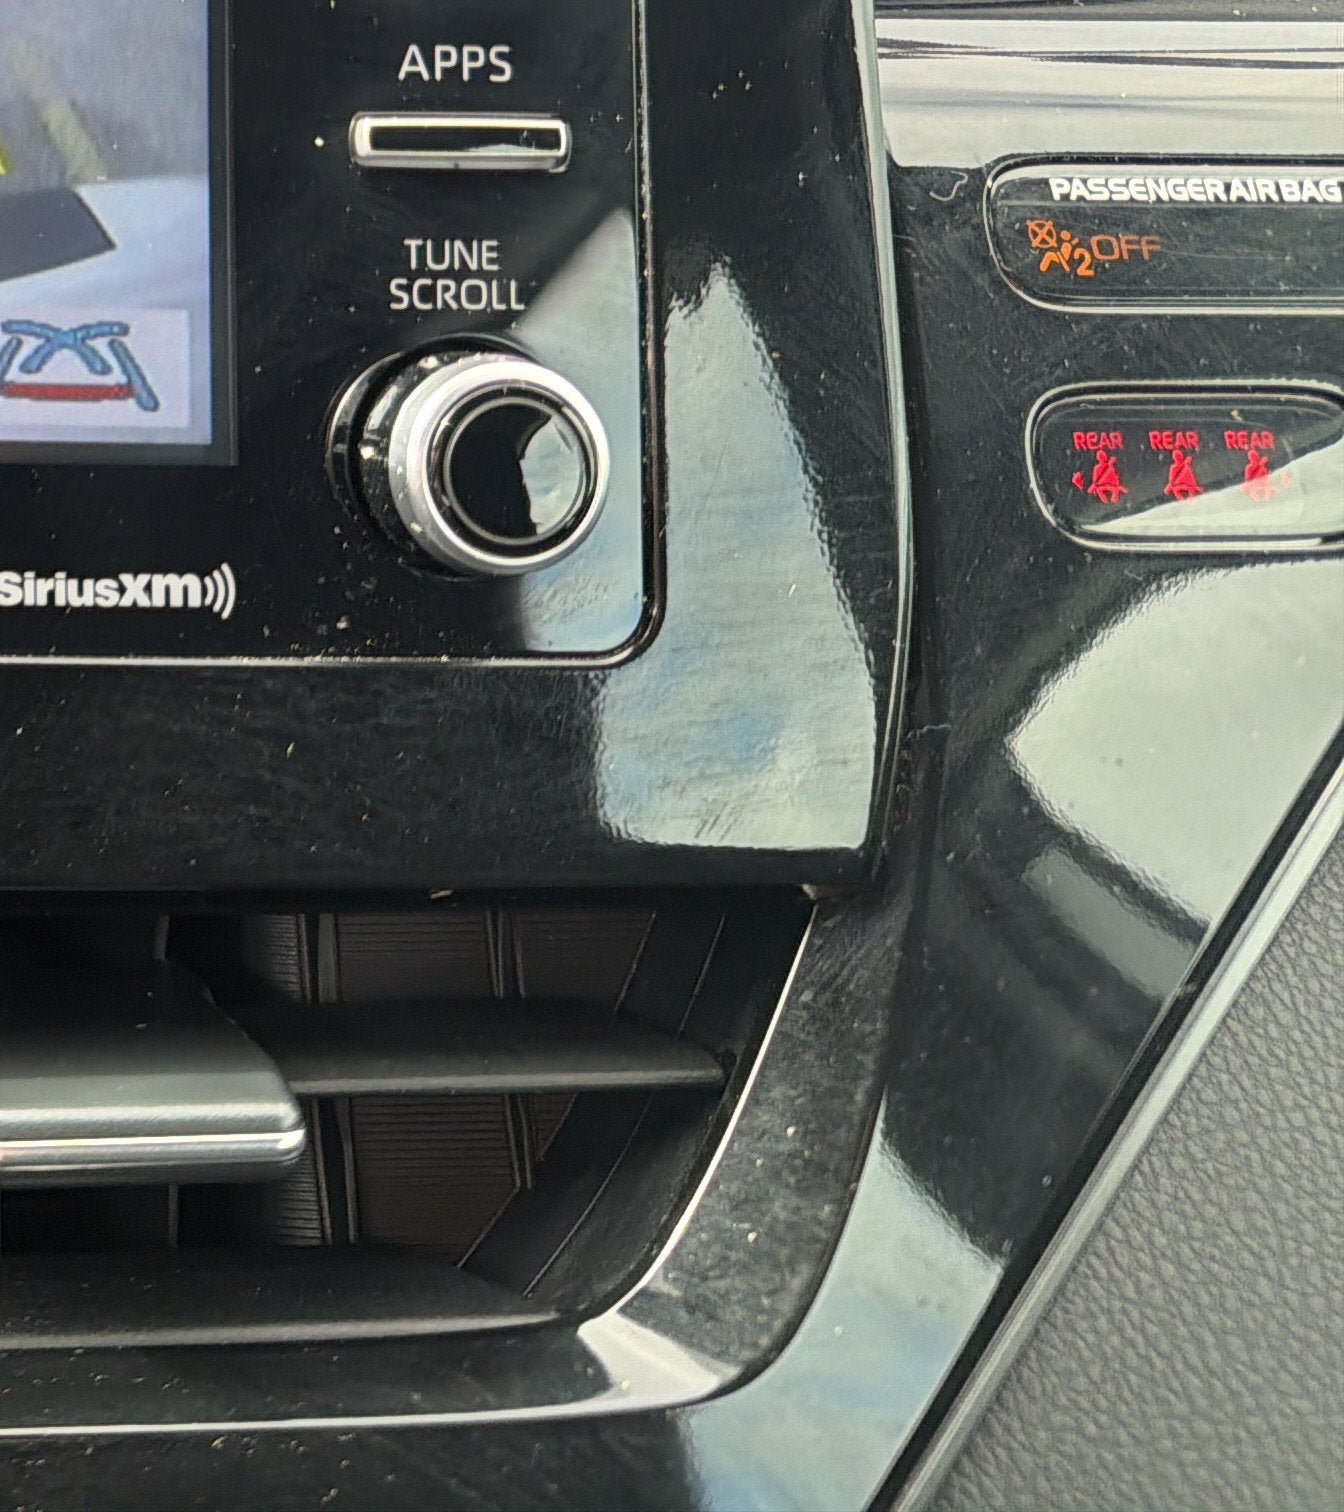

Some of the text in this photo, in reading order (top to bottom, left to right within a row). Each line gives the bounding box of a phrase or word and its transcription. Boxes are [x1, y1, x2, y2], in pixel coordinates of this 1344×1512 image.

[398, 43, 513, 83] APPS
[1048, 177, 1227, 202] PASSENGER
[404, 239, 500, 272] TUNE
[1089, 234, 1162, 262] OFF
[389, 277, 525, 311] SCROLL
[1072, 431, 1124, 450] REAR
[1148, 431, 1200, 450] REAR
[1224, 430, 1275, 450] REAR
